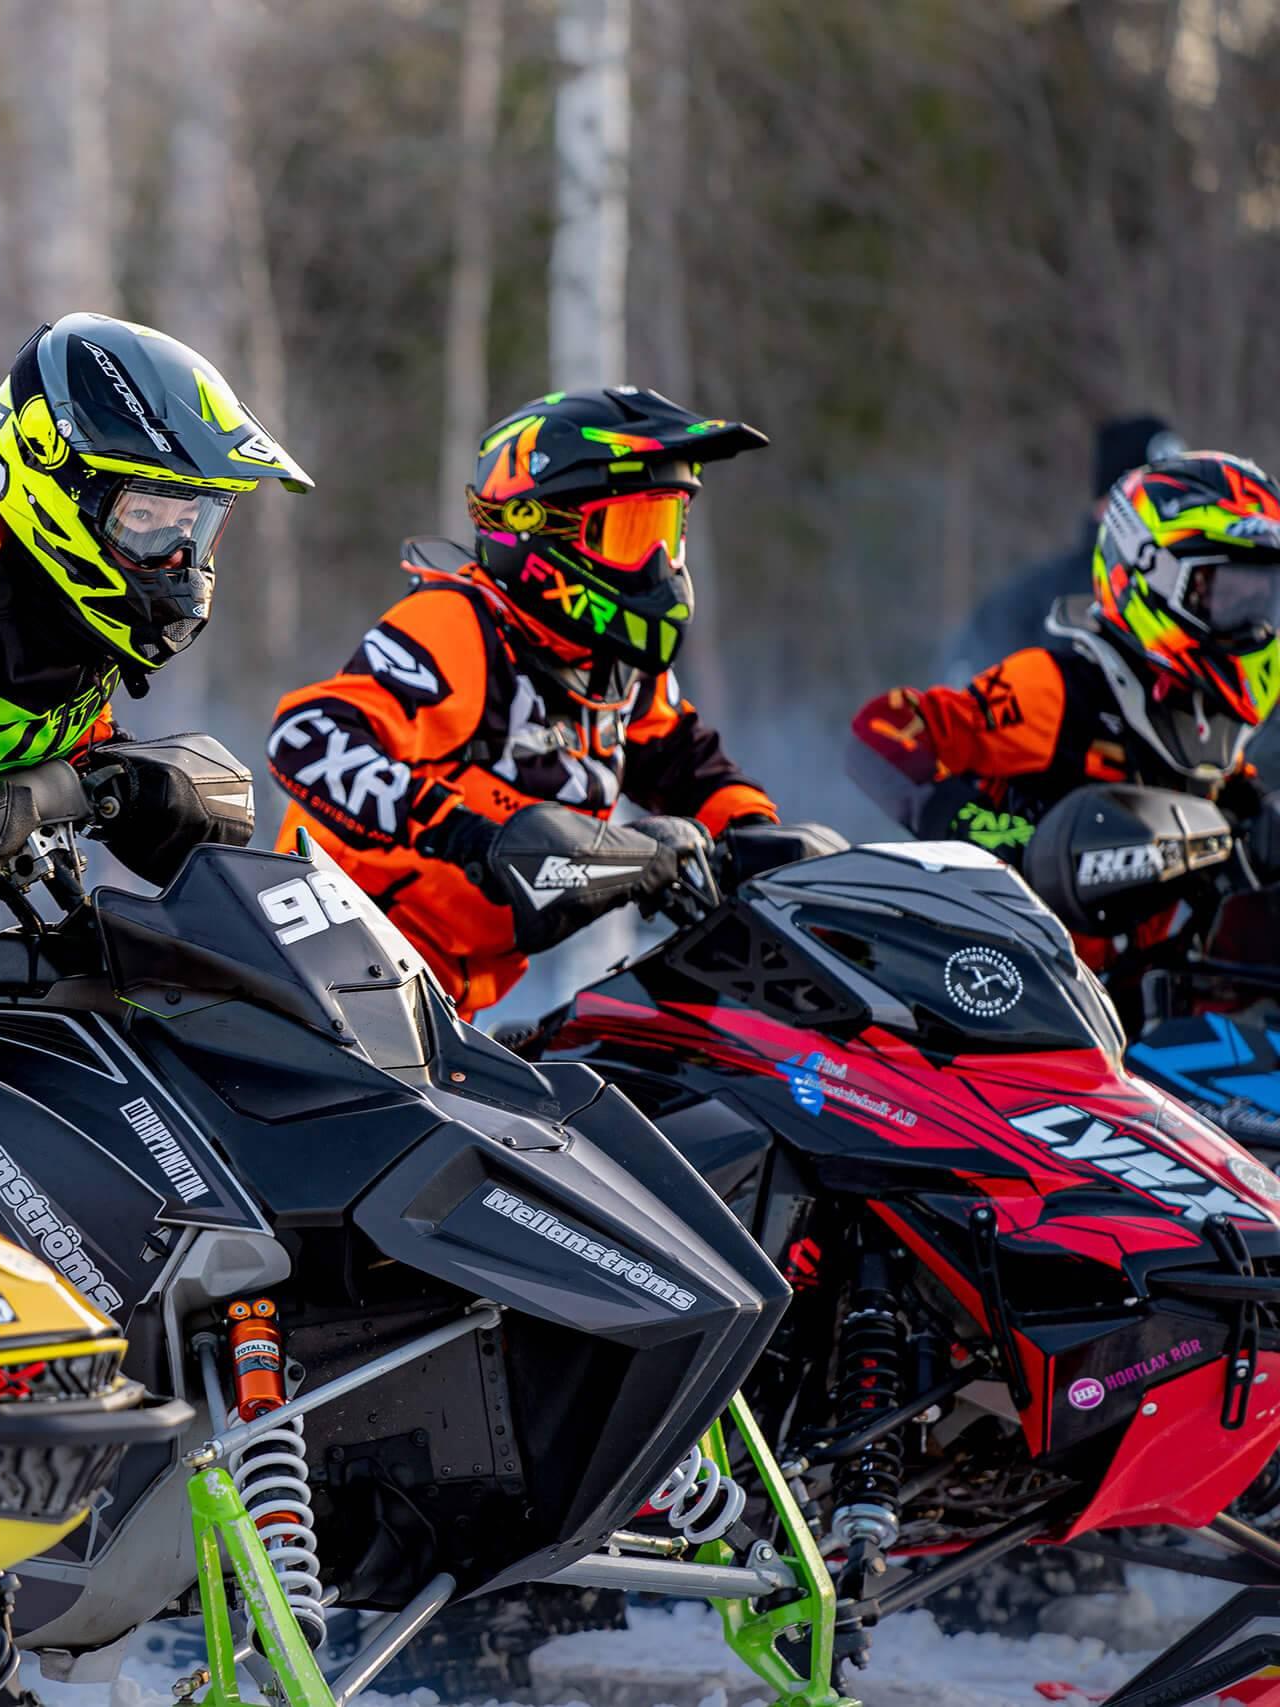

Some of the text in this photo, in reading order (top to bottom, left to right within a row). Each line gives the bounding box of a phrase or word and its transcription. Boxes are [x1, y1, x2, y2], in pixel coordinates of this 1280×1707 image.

[521, 552, 618, 635] FXR
[268, 707, 412, 834] FXR
[311, 795, 365, 835] DIVISION
[256, 870, 361, 946] 98
[1009, 1104, 1269, 1222] LYNX
[482, 1187, 697, 1311] Mellanströms
[1104, 1338, 1203, 1391] HORTLAX RÖR
